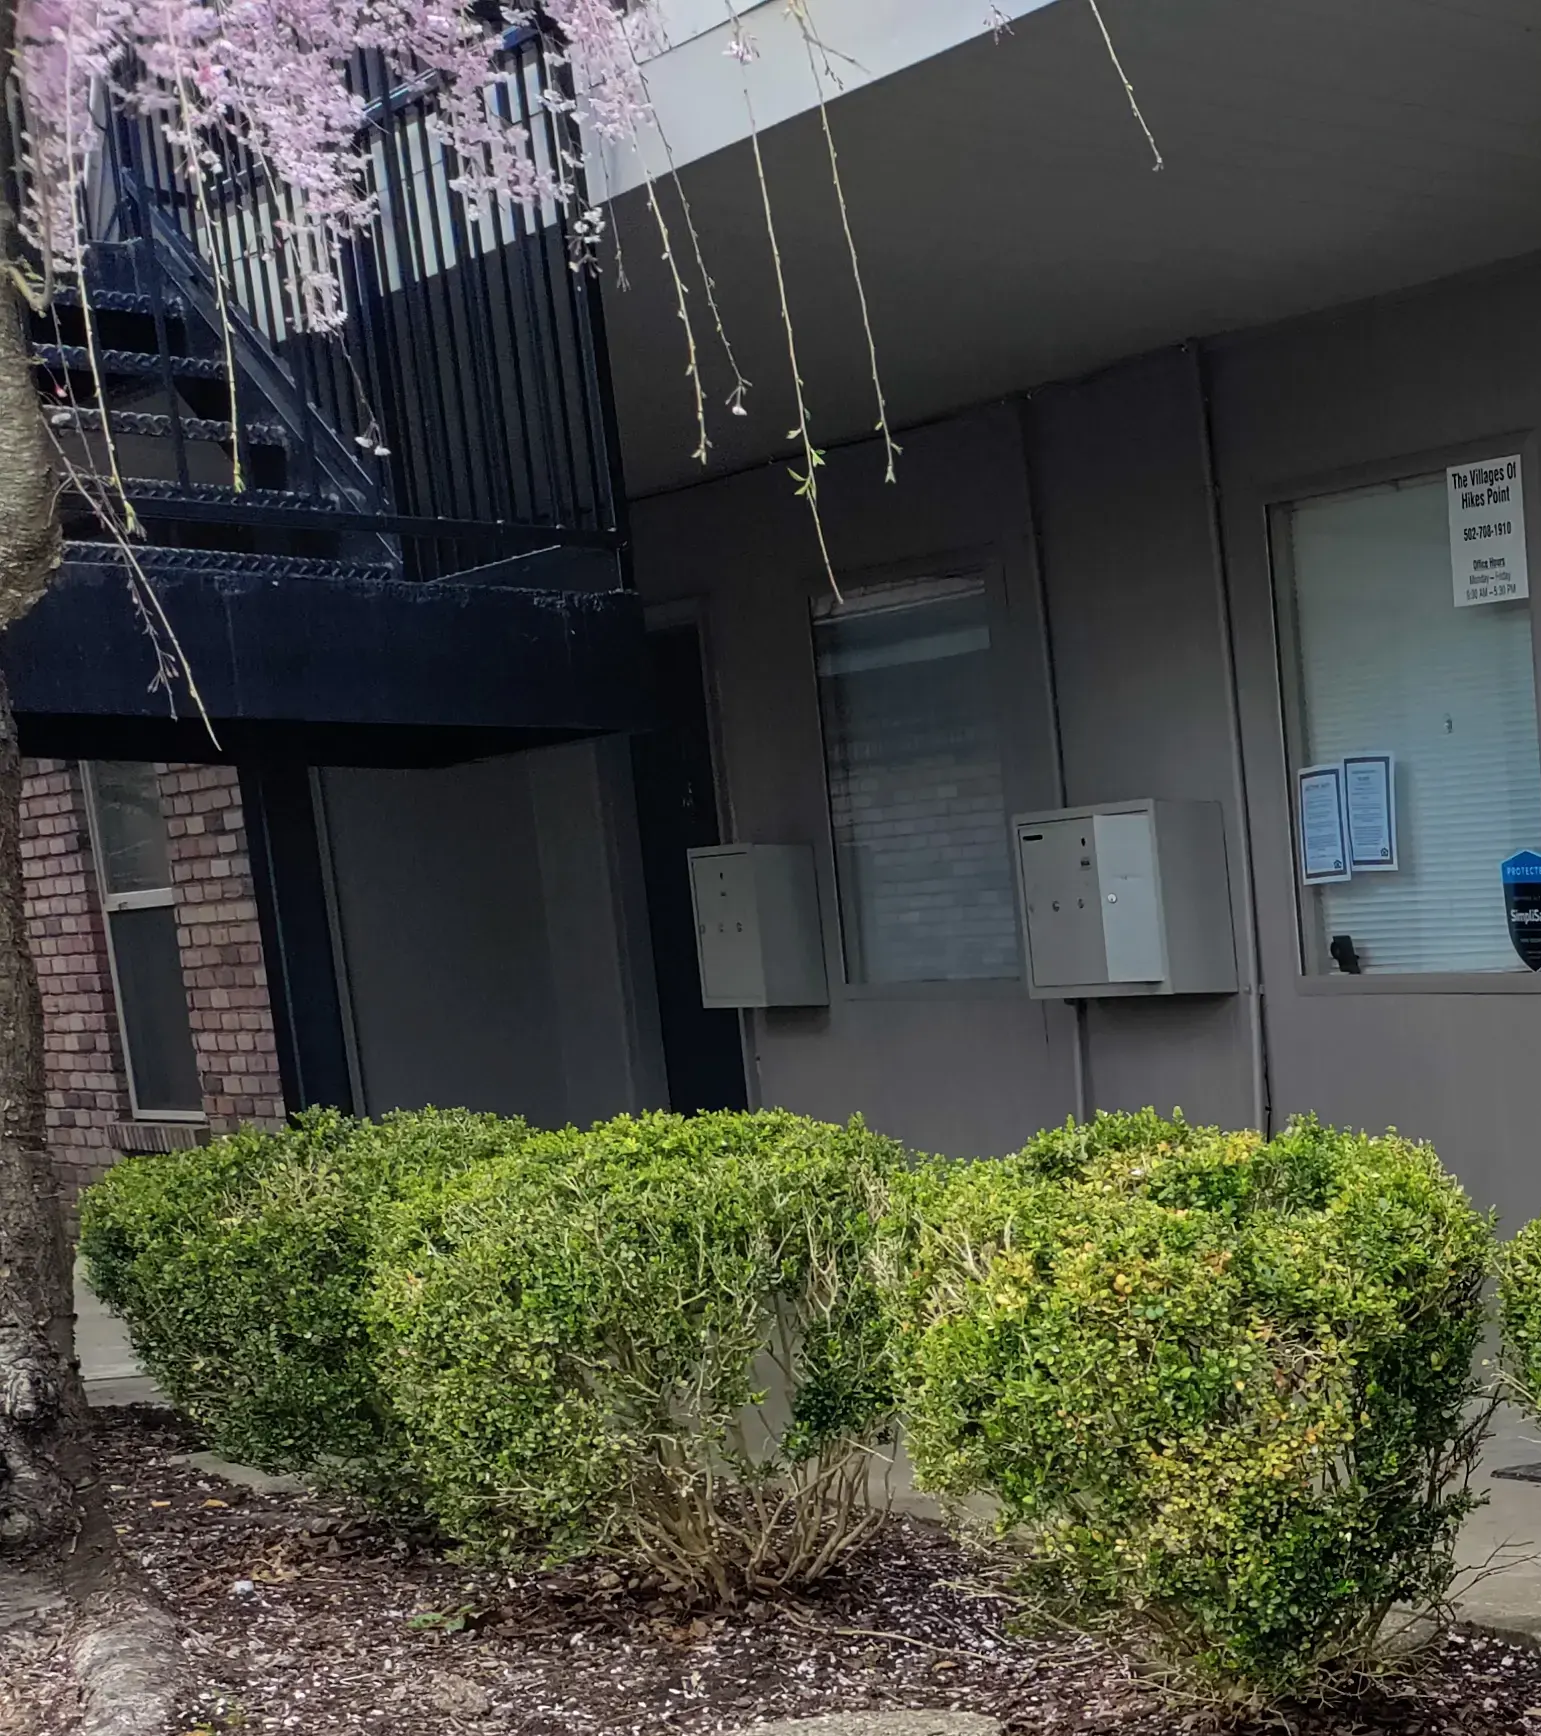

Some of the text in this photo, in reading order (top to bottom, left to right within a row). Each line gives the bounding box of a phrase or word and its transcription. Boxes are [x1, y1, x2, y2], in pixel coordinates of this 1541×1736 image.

[1451, 461, 1517, 490] The Villages Of
[1461, 485, 1511, 510] Hikes Point
[1463, 521, 1512, 541] 502-708-1910
[1472, 557, 1505, 571] Office Hours
